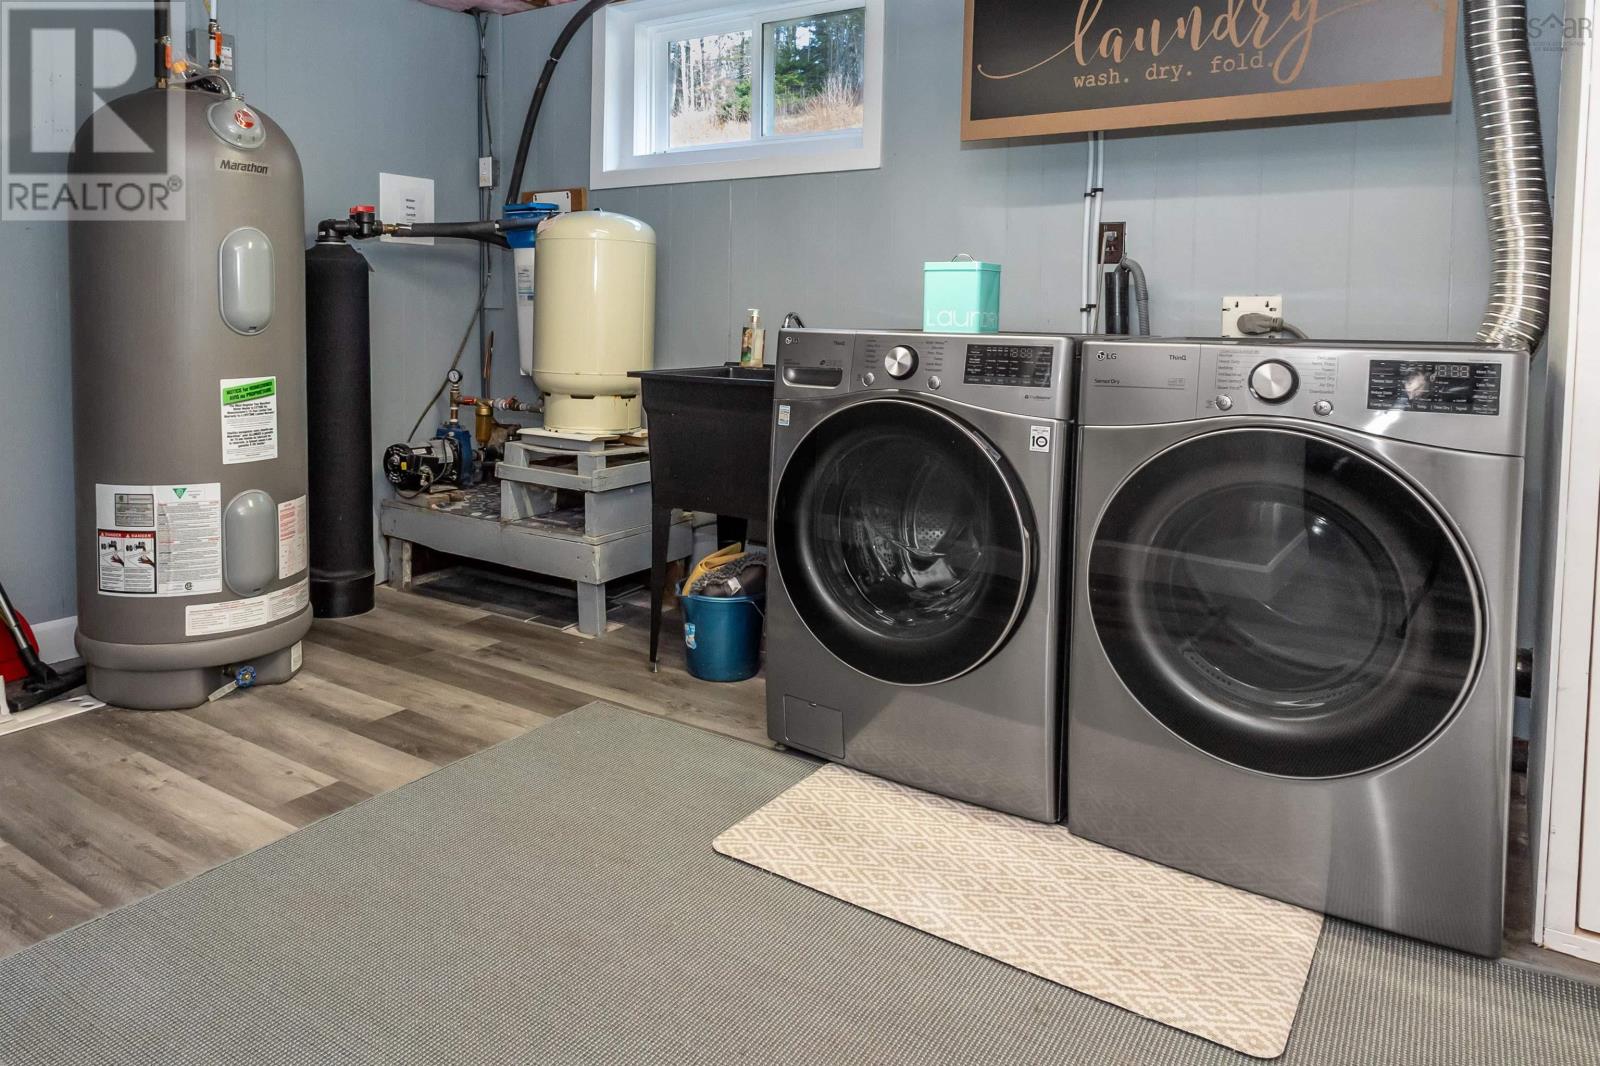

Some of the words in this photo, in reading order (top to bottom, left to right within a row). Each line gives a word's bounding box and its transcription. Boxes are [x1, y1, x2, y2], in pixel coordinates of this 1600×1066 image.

[1073, 68, 1129, 88] wash.
[1145, 63, 1193, 82] dry.
[1210, 50, 1274, 74] fold.
[219, 159, 269, 174] Marathon
